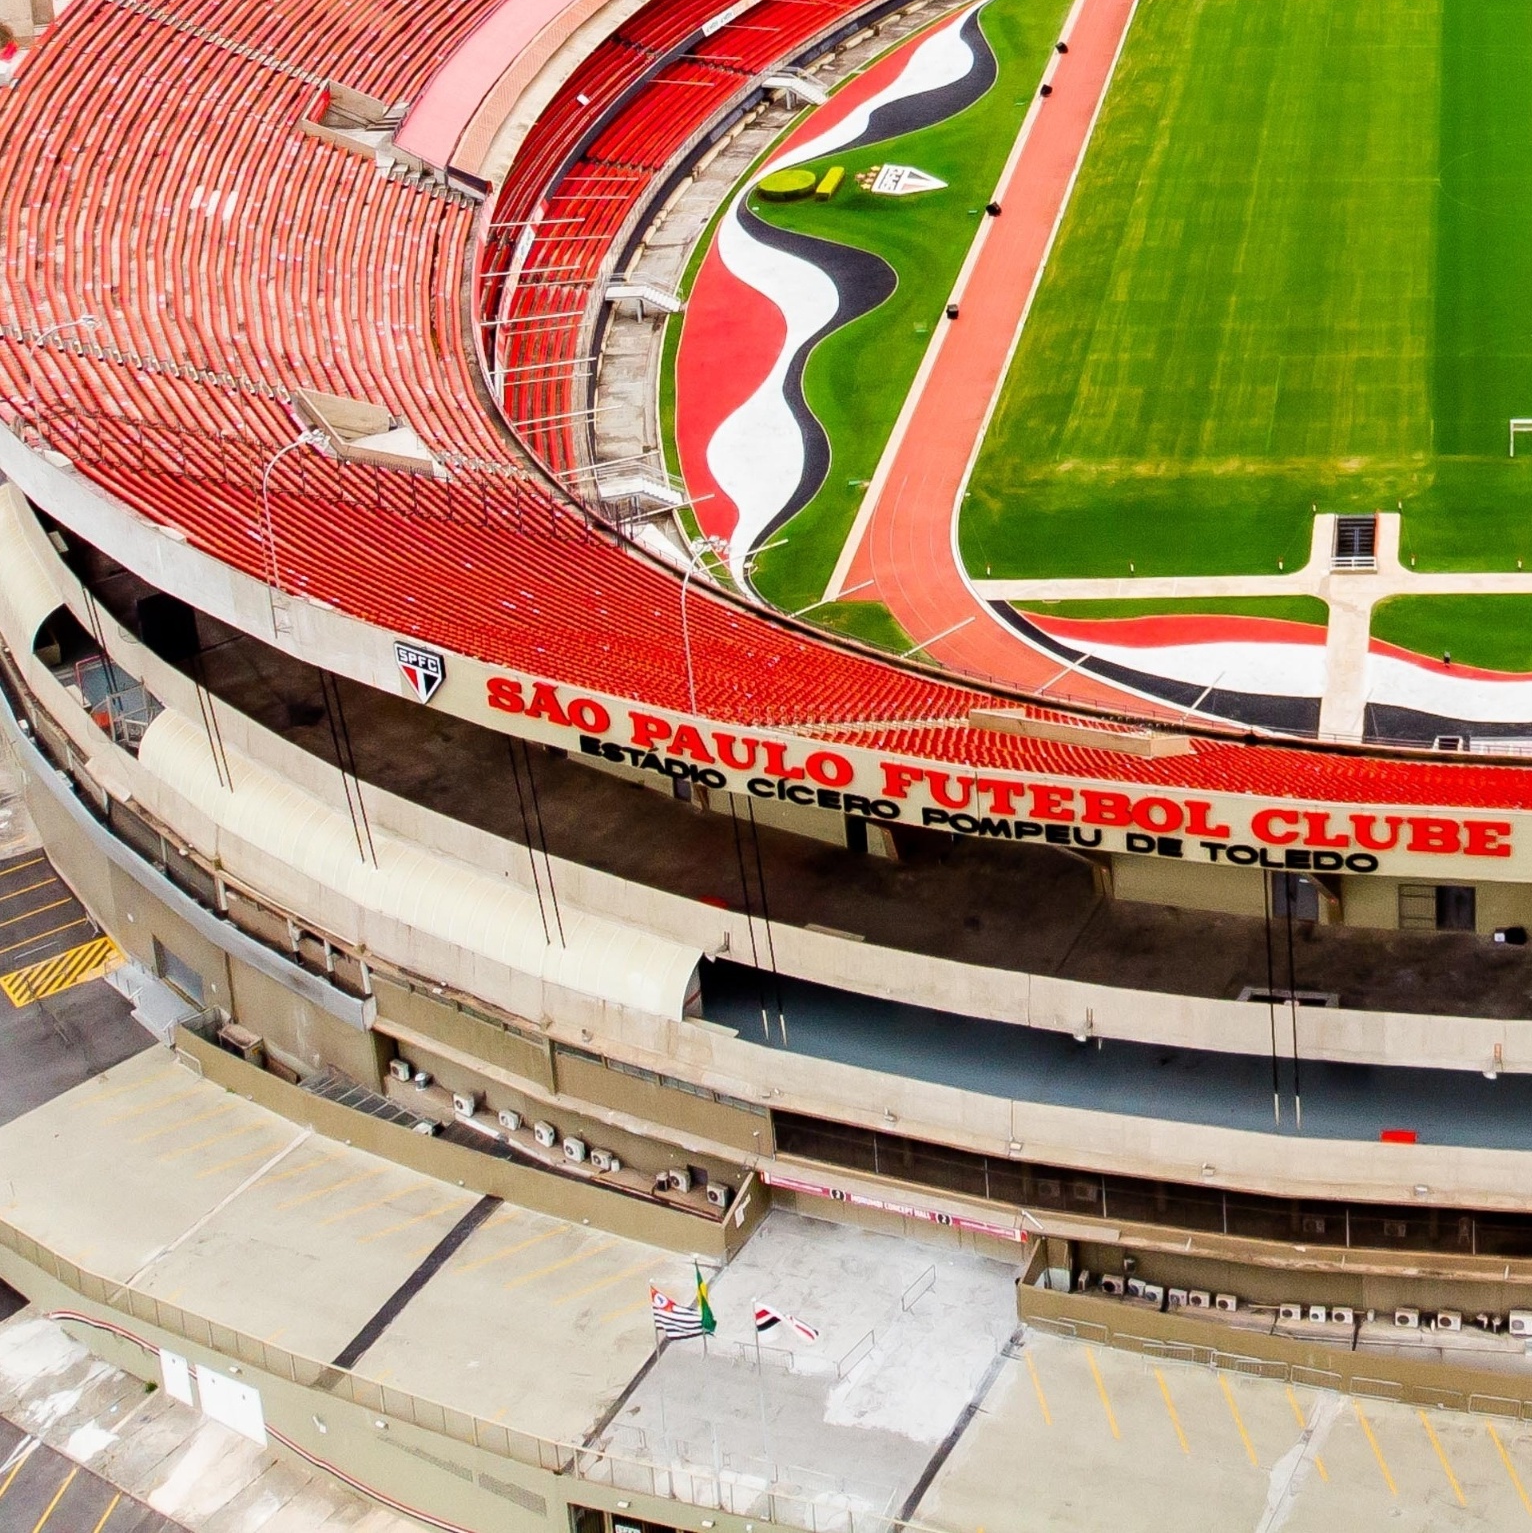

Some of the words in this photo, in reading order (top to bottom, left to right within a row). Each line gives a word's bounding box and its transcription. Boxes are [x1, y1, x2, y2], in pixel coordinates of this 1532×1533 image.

[398, 648, 438, 672] SPFC
[487, 677, 610, 734] SÃO
[629, 711, 854, 788] PAULO
[880, 763, 1230, 839] FUTEBOL
[1251, 808, 1512, 858] CLUBE
[580, 734, 727, 789] ESTÁDIO
[747, 777, 901, 820] CÍCERO
[922, 807, 1102, 848] POMPEU
[1126, 832, 1184, 859] DE
[1200, 841, 1379, 874] TOLEDO
